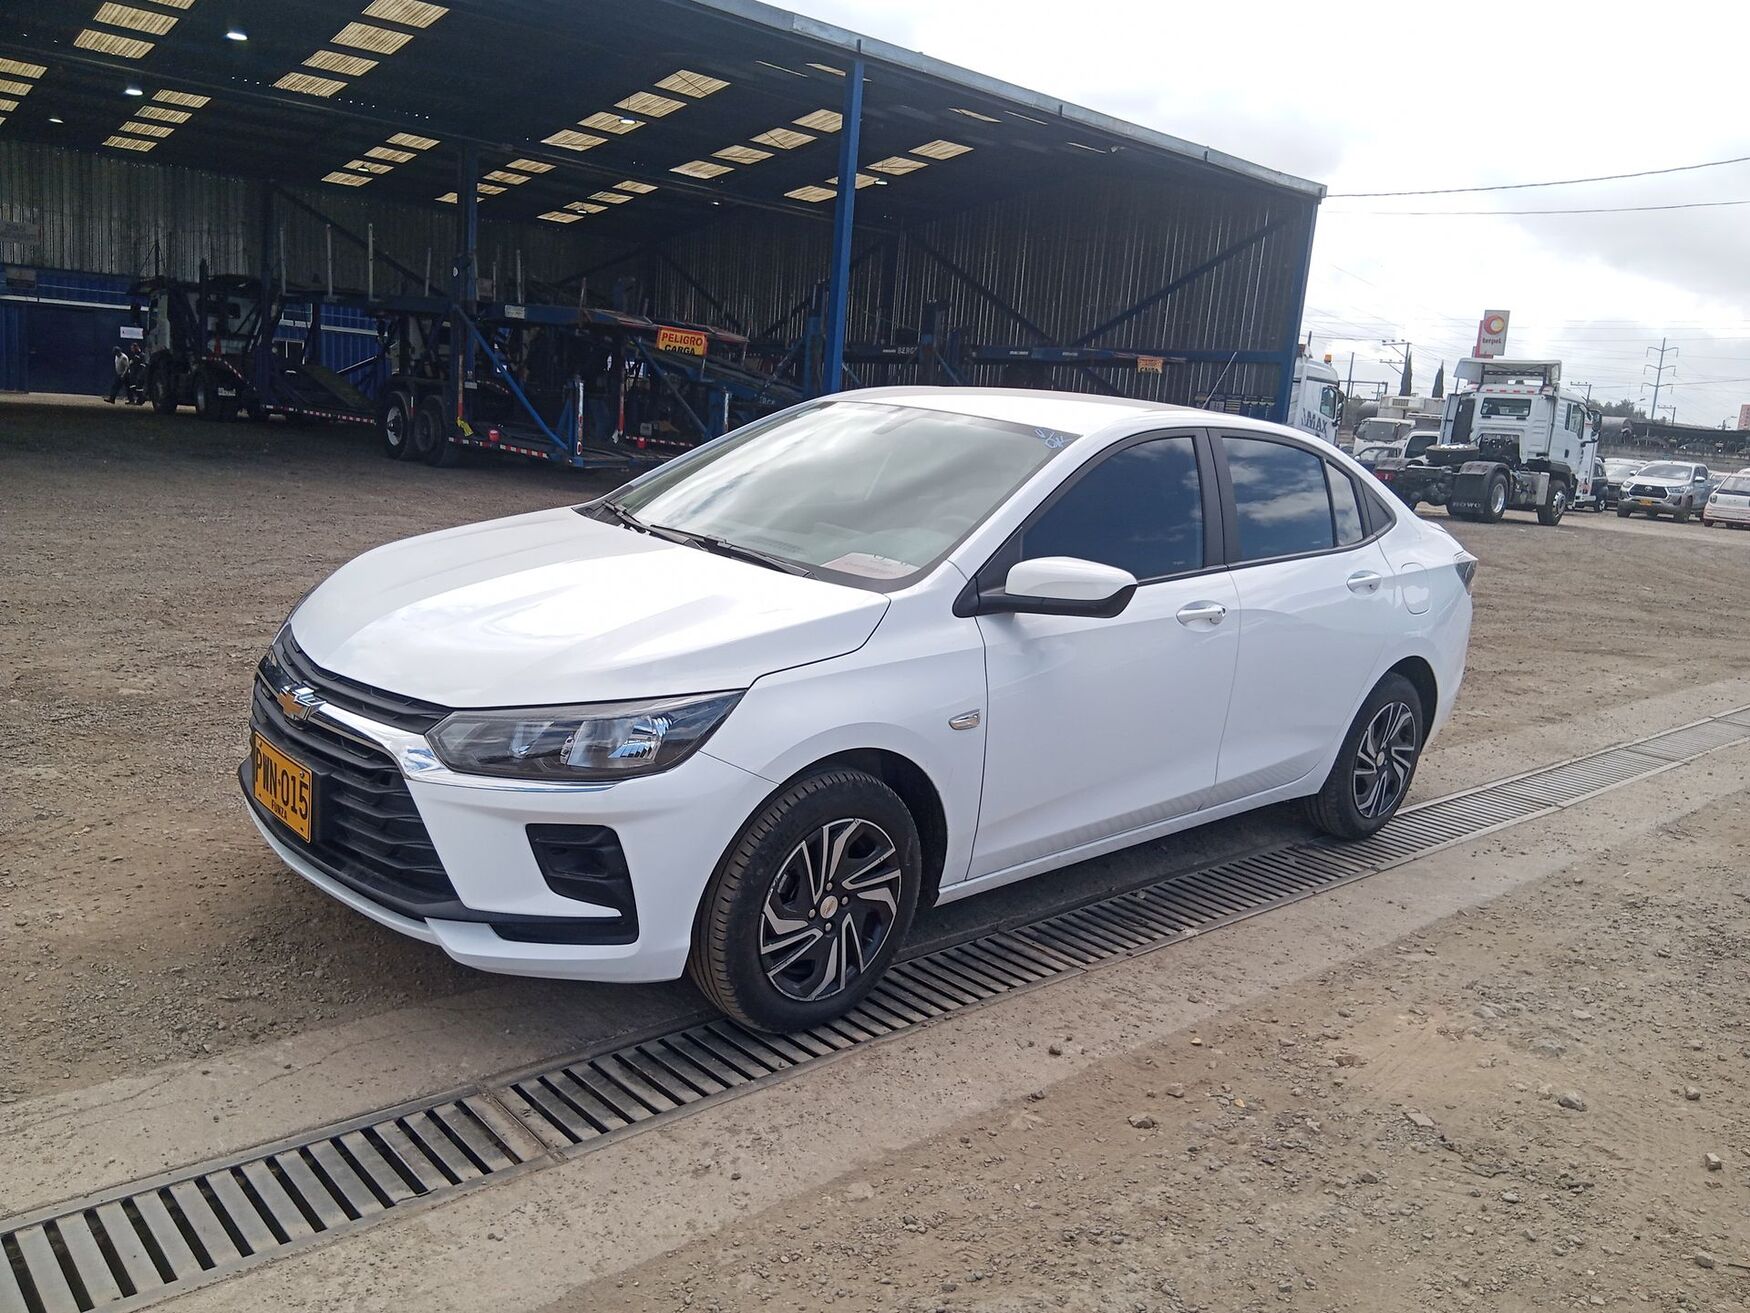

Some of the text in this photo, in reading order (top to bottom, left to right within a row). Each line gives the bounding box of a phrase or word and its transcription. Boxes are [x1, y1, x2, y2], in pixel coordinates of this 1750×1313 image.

[661, 332, 704, 346] PELIGRO
[1482, 337, 1502, 345] terpel
[664, 344, 696, 356] CARGA
